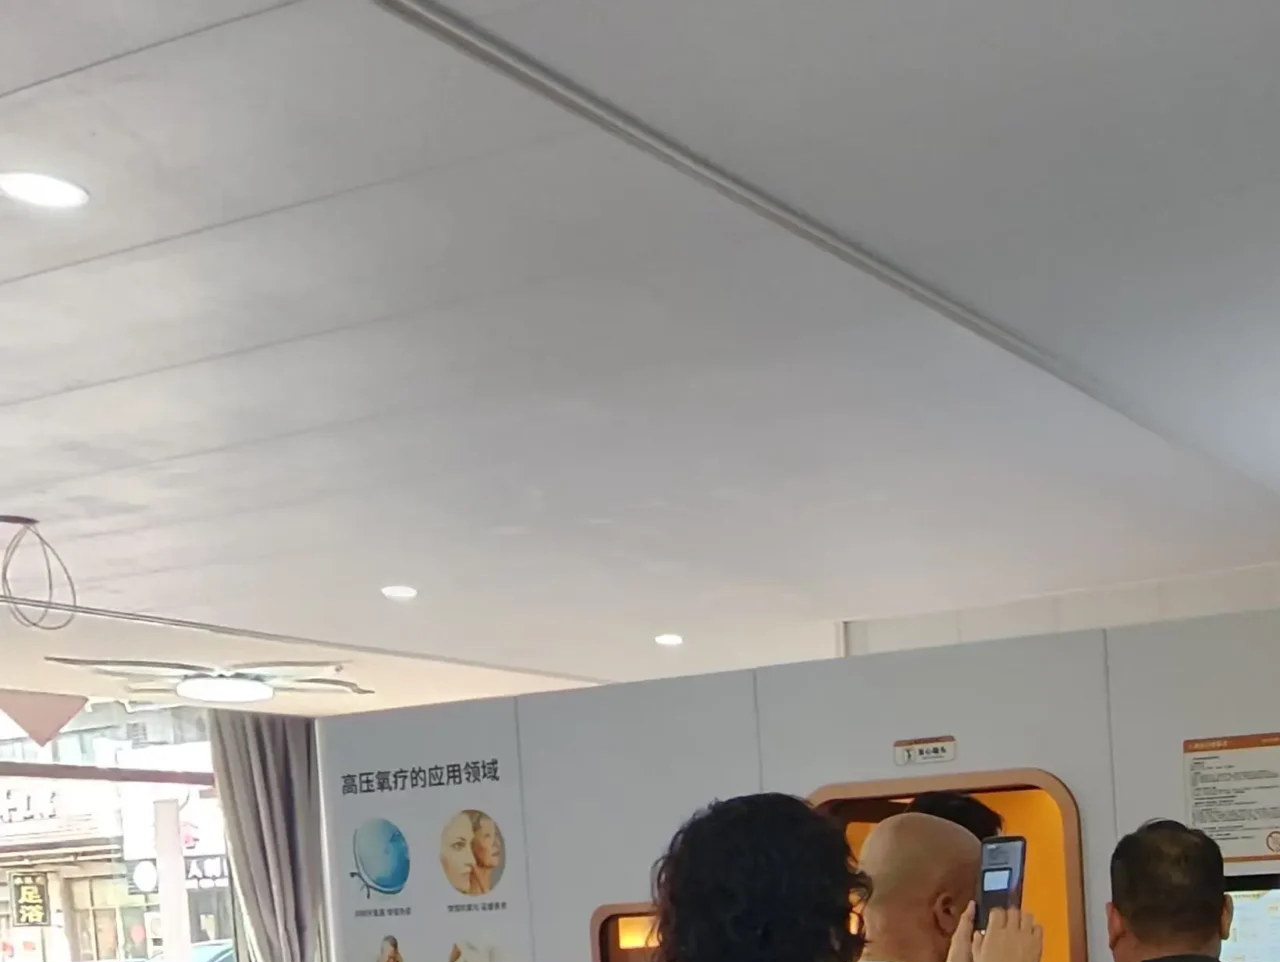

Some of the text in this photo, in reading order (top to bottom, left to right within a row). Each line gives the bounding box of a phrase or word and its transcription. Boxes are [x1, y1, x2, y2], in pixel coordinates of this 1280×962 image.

[341, 758, 500, 796] 高压氧疗的应用领域
[18, 885, 45, 923] 足浴
